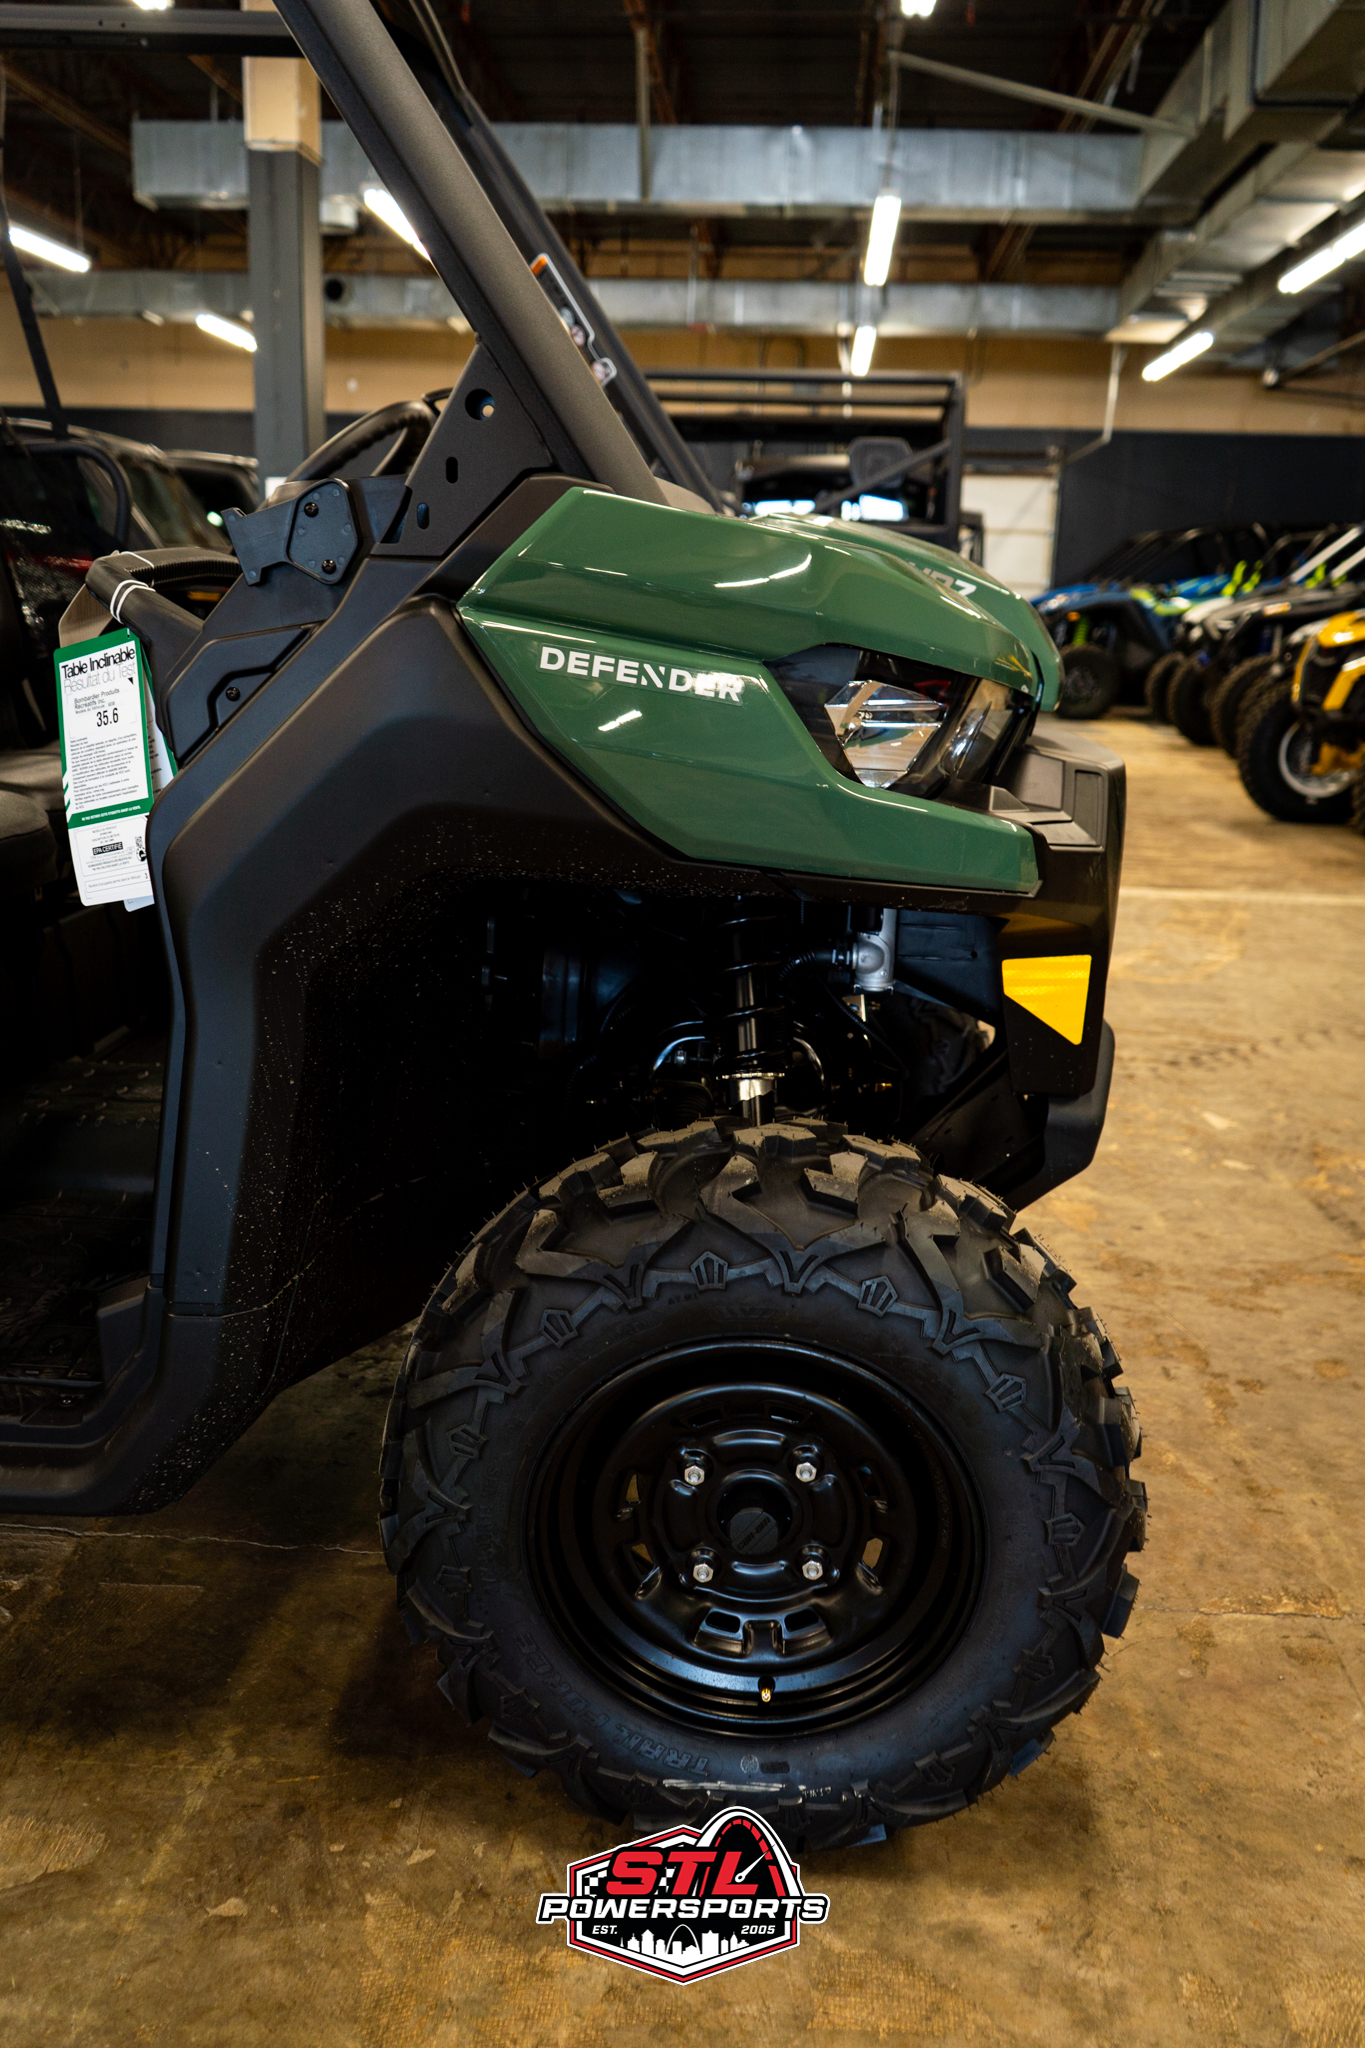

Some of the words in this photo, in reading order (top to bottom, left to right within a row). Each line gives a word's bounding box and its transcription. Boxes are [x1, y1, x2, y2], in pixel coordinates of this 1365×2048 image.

[61, 661, 88, 679] Table
[89, 646, 136, 672] Inclinable
[102, 668, 116, 684] du
[118, 662, 137, 679] Test
[539, 646, 745, 702] DEFENDER
[96, 707, 119, 728] 35.6
[93, 847, 103, 855] EPA
[513, 1634, 610, 1728] FORCE
[616, 1722, 710, 1776] TRAIL
